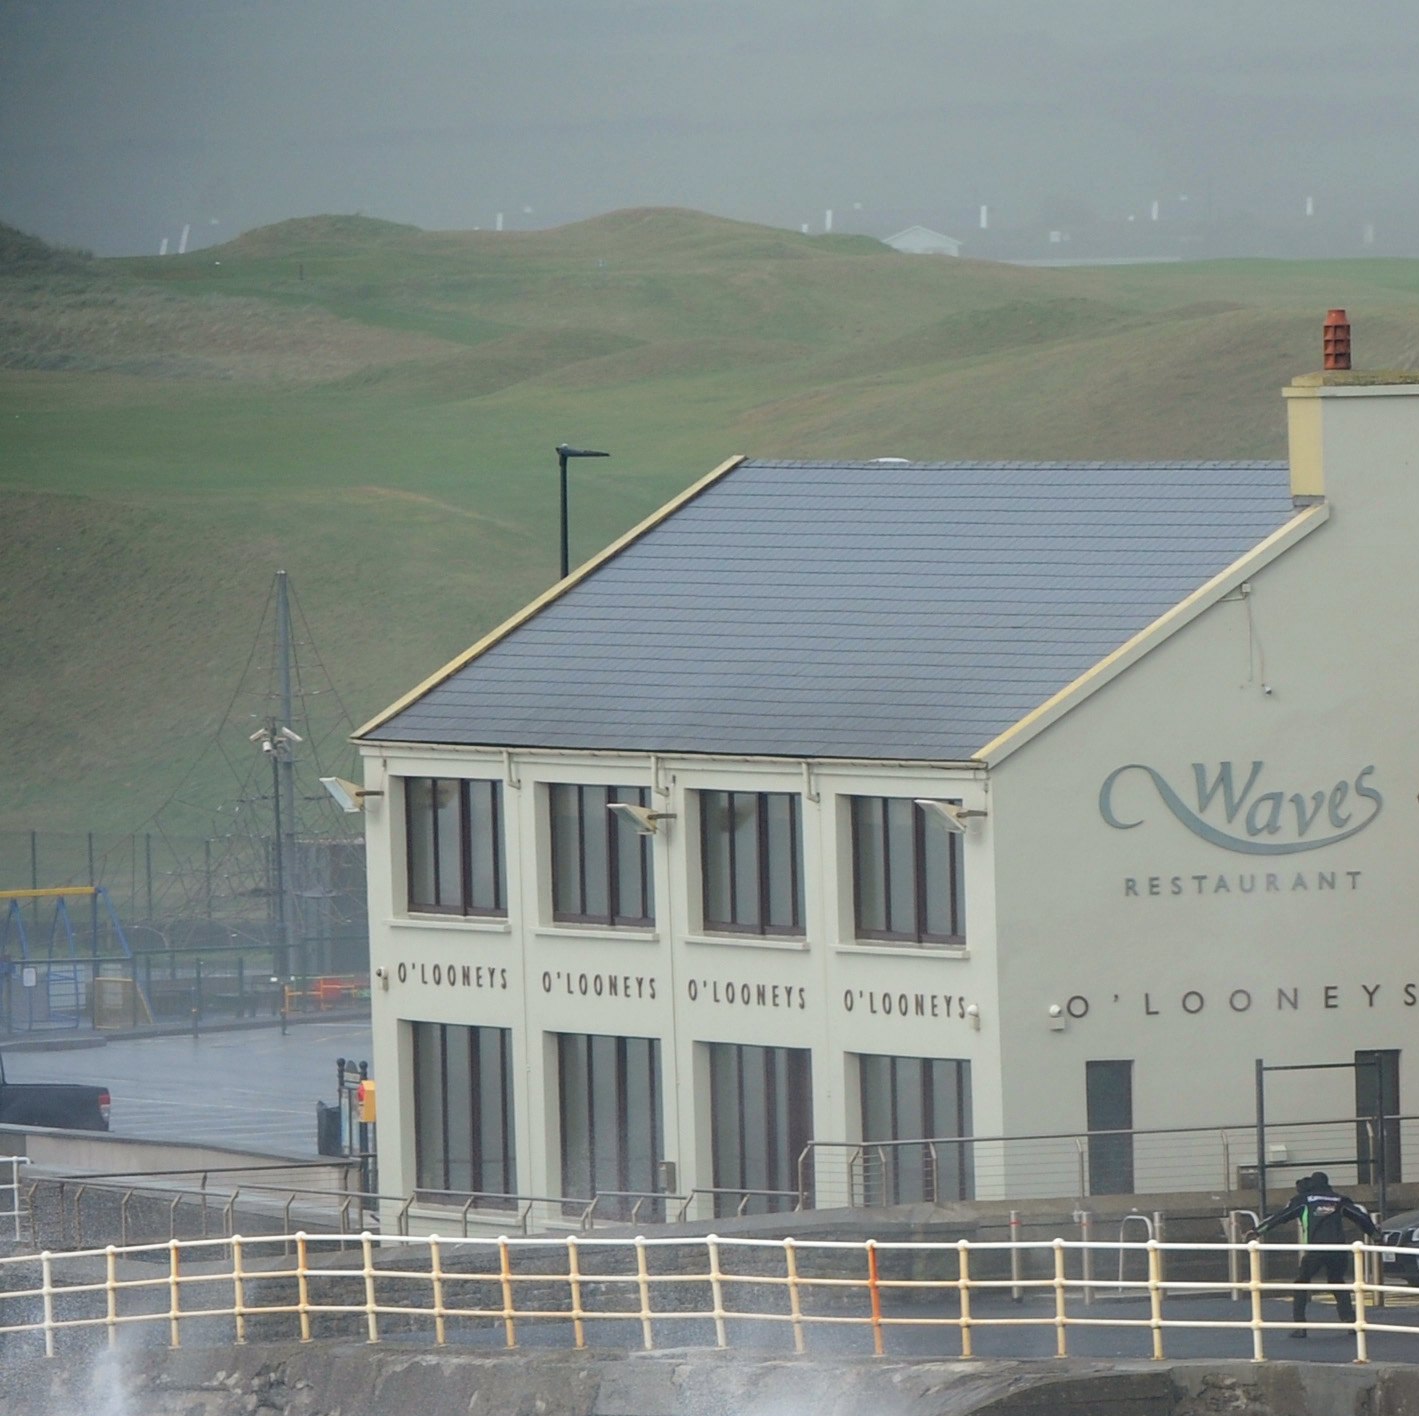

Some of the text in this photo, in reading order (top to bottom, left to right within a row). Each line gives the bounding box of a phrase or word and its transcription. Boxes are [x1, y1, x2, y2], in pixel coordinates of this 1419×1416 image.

[1099, 760, 1383, 856] Waves
[1124, 871, 1362, 897] RESTAURANT
[397, 962, 508, 990] O'LOONEYS
[542, 971, 656, 999] O'LOONEYS
[687, 979, 806, 1009] O'LOONEYS
[843, 989, 966, 1019] O'LOONEYS
[1066, 983, 1418, 1019] O'LOONEYS
